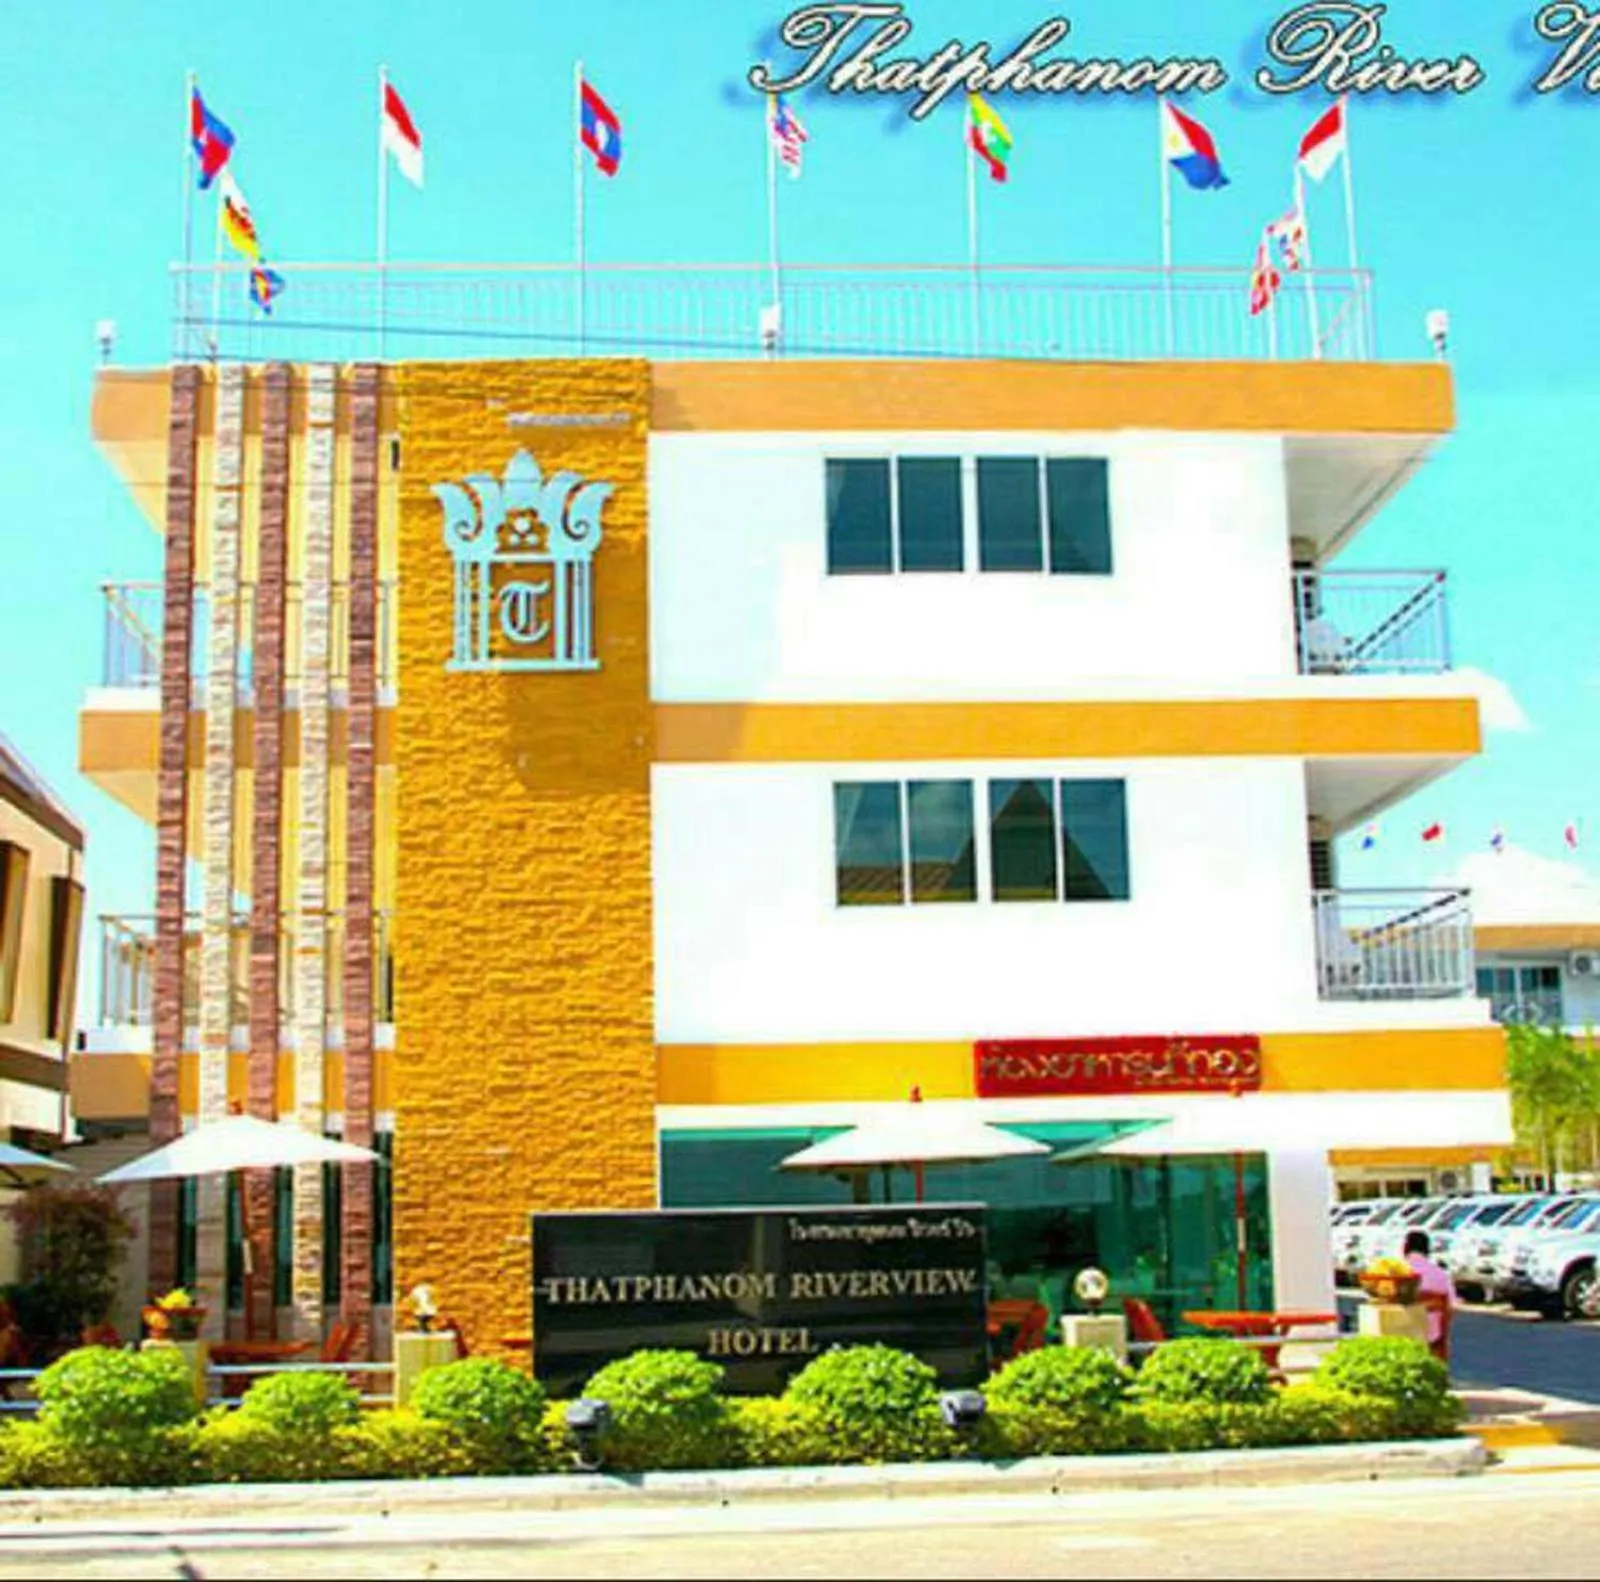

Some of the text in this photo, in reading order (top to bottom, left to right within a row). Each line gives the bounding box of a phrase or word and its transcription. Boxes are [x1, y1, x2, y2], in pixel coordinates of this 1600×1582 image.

[500, 580, 549, 643] T
[546, 1269, 978, 1304] THATPHANOM RIVERVIEW
[708, 1327, 815, 1356] HOTEL
